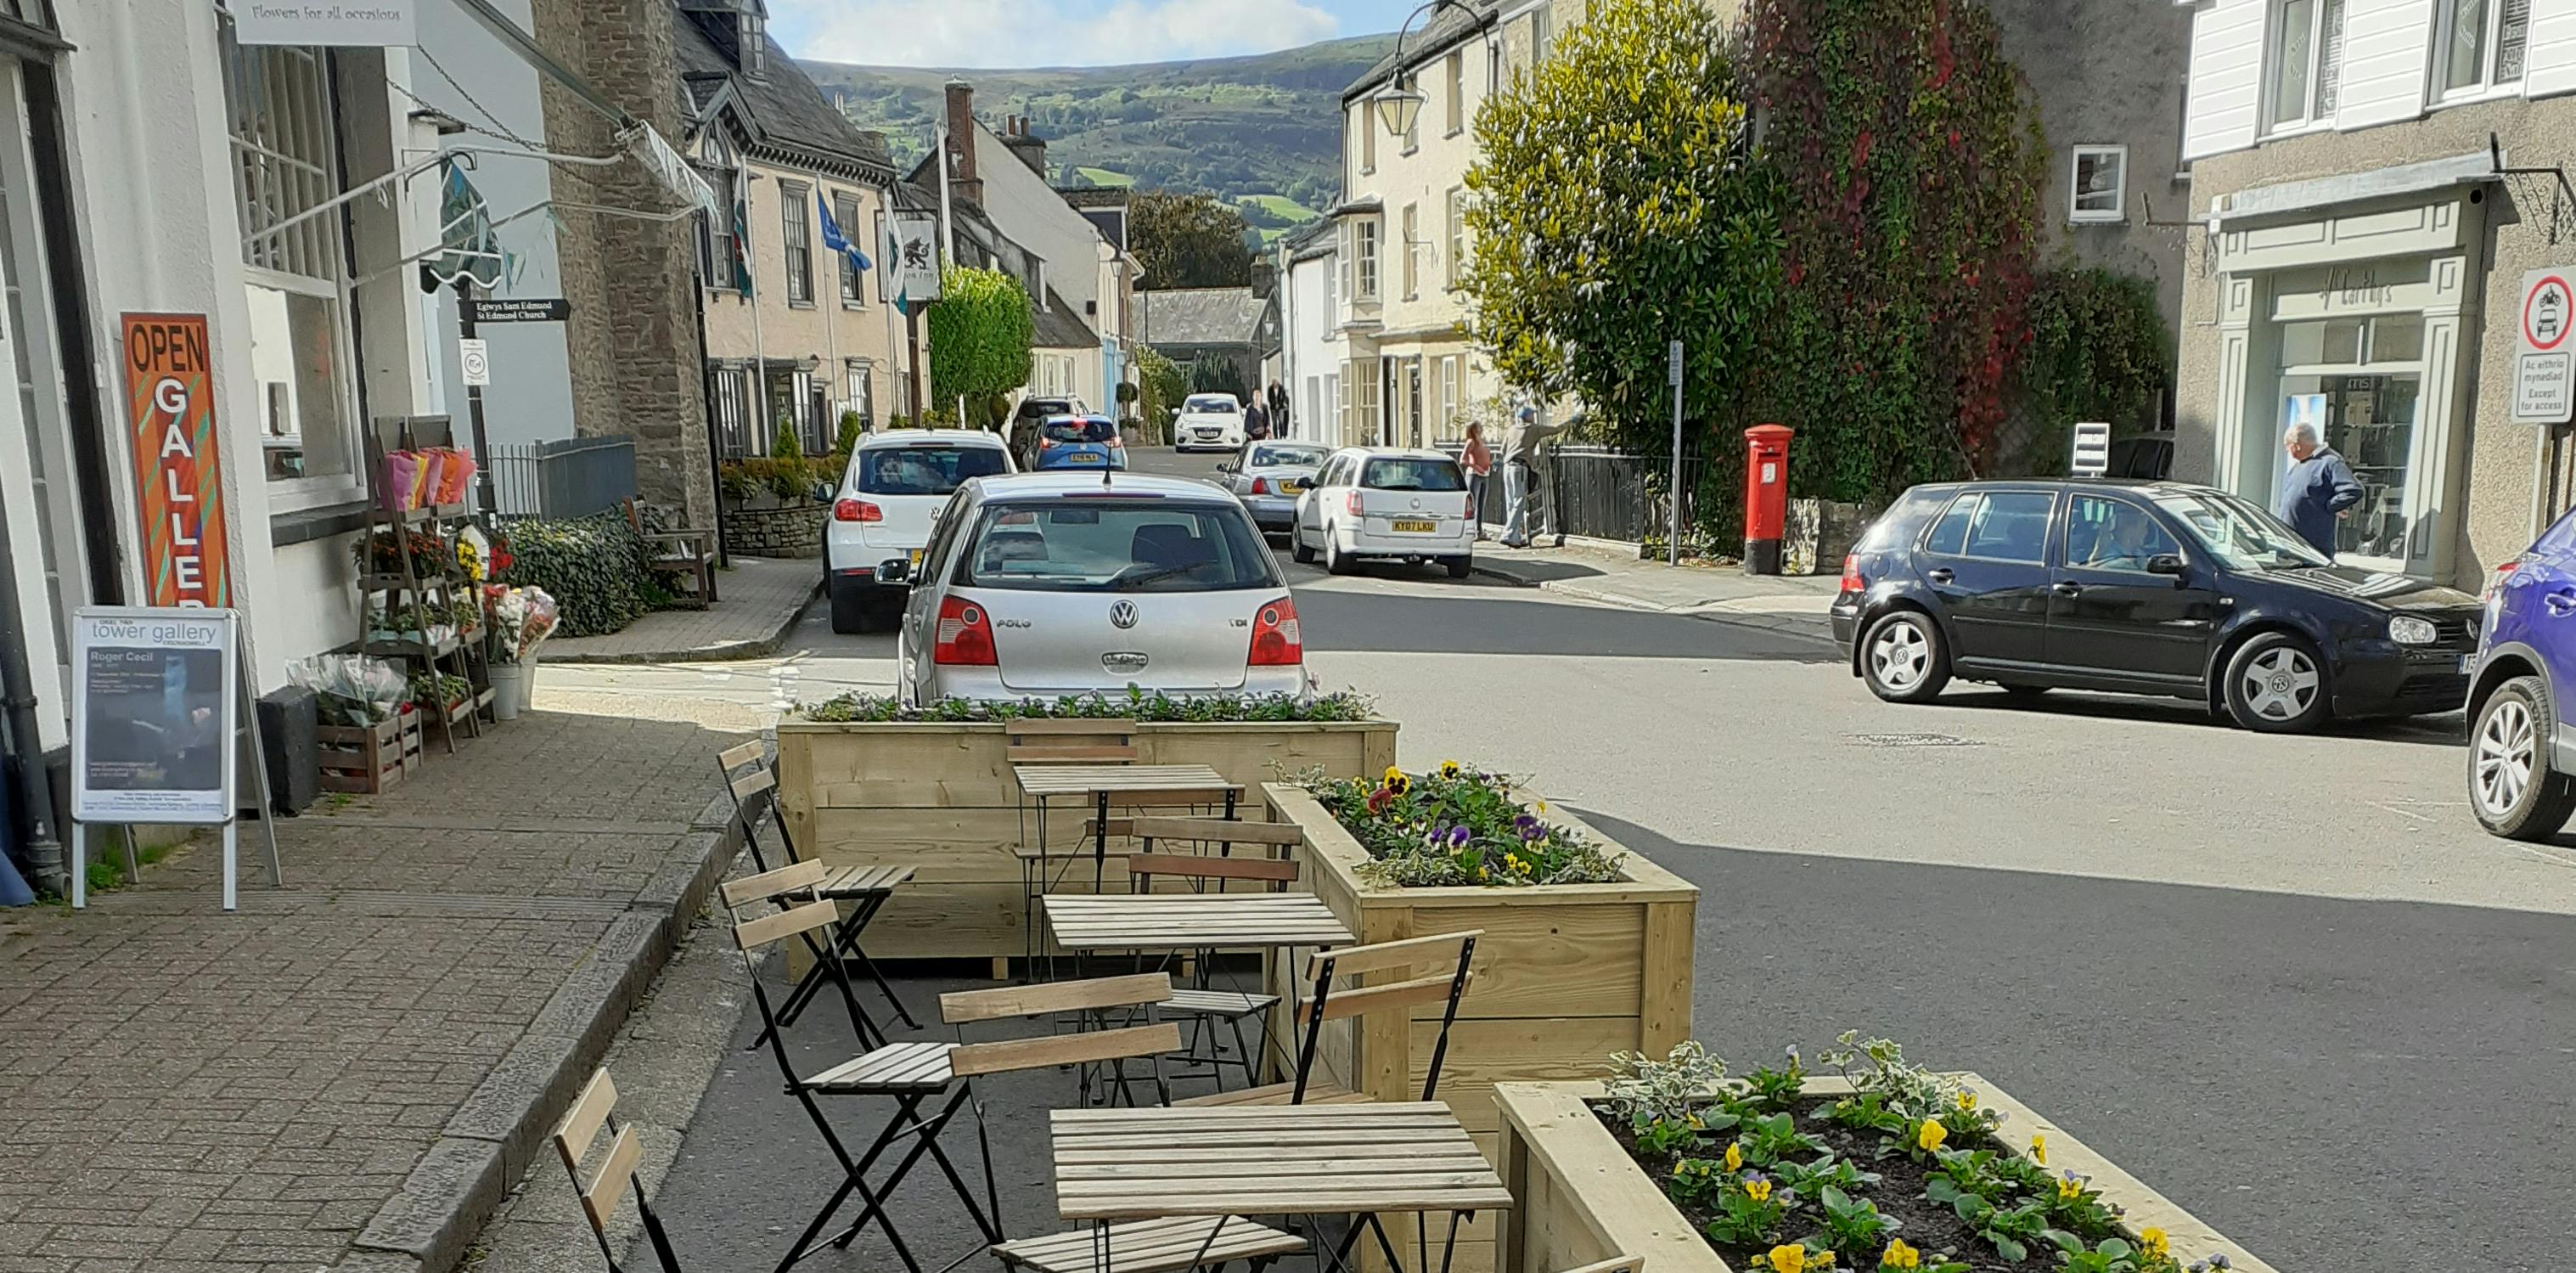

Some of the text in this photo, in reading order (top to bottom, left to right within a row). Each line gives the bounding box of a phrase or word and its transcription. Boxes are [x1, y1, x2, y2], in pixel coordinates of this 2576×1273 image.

[252, 4, 401, 21] Flowers for all occasions
[521, 301, 553, 310] Edmund
[487, 311, 517, 319] Edmund
[518, 310, 547, 319] Church
[132, 323, 205, 373] OPEN
[2525, 359, 2535, 369] Ac
[2524, 371, 2563, 384] mynediad
[2528, 388, 2556, 399] Except
[2521, 401, 2562, 410] for access
[1393, 521, 1434, 531] KY07 LKU
[996, 618, 1032, 628] POLO
[1229, 618, 1248, 628] TDI
[93, 622, 217, 644] tower gallery
[91, 651, 154, 663] Roger Cecil
